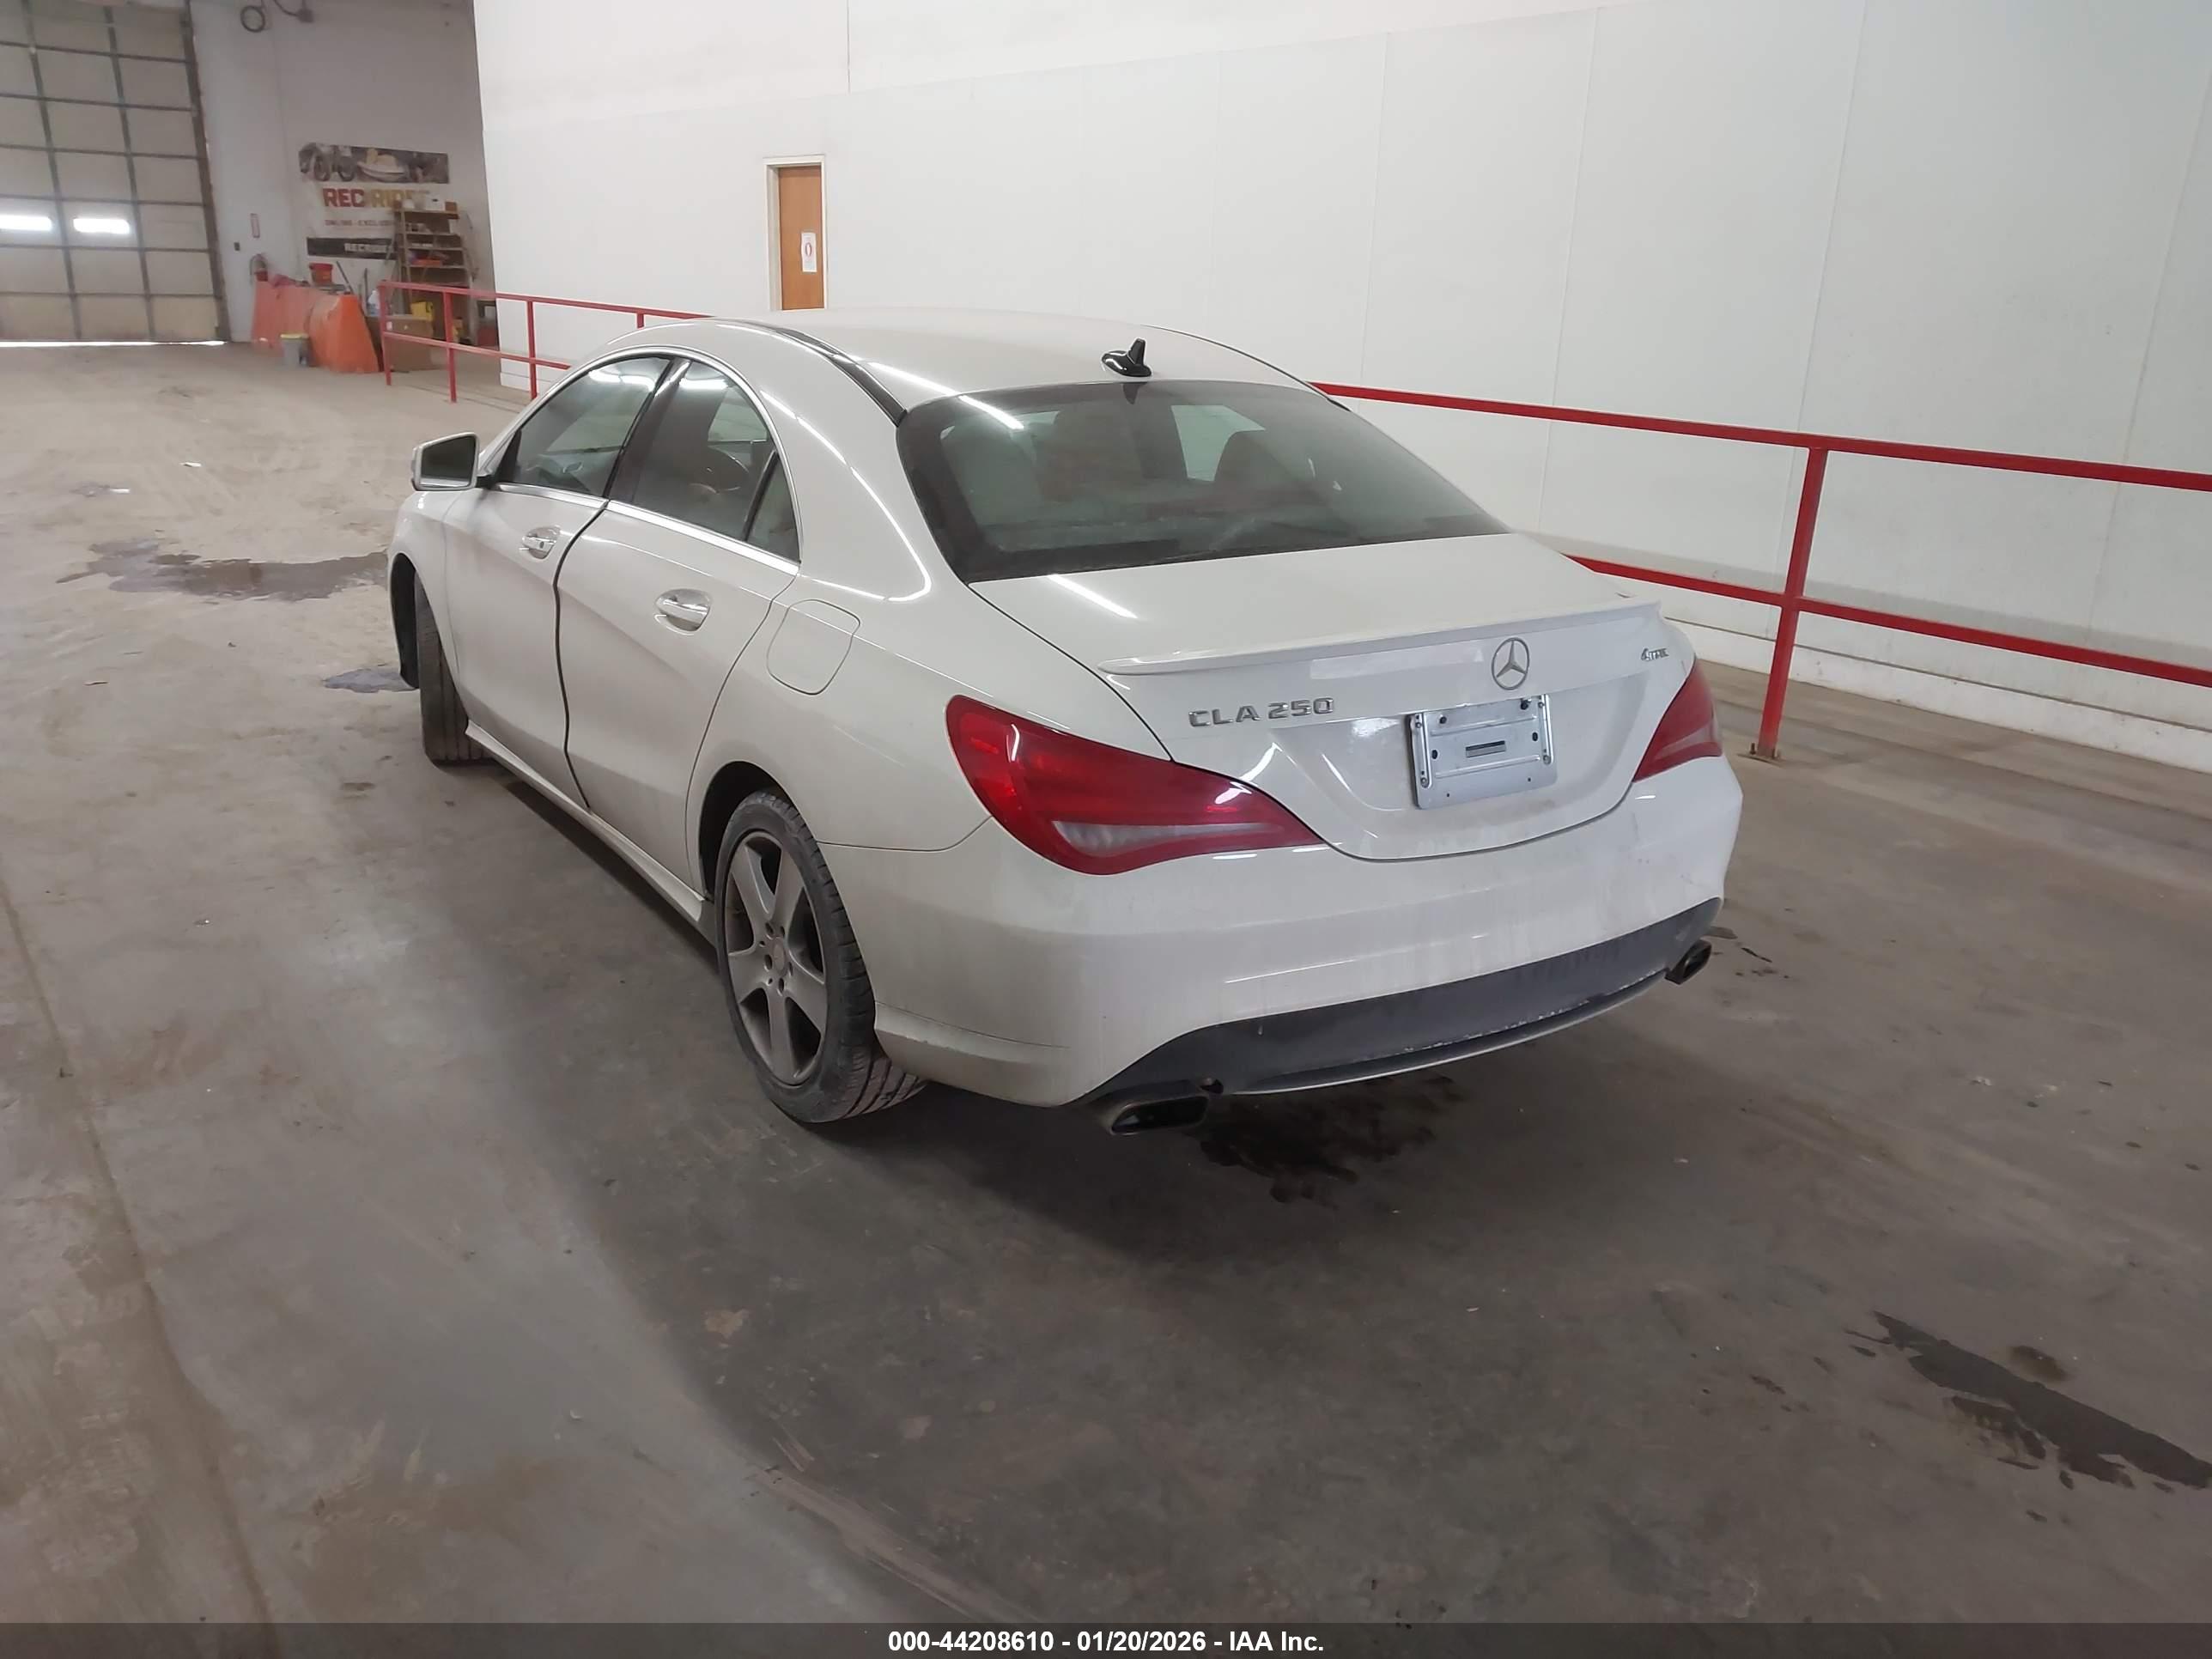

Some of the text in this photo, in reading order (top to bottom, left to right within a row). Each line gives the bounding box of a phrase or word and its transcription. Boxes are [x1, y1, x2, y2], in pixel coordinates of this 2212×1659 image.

[322, 187, 365, 208] REC
[1188, 696, 1334, 727] CLA 250
